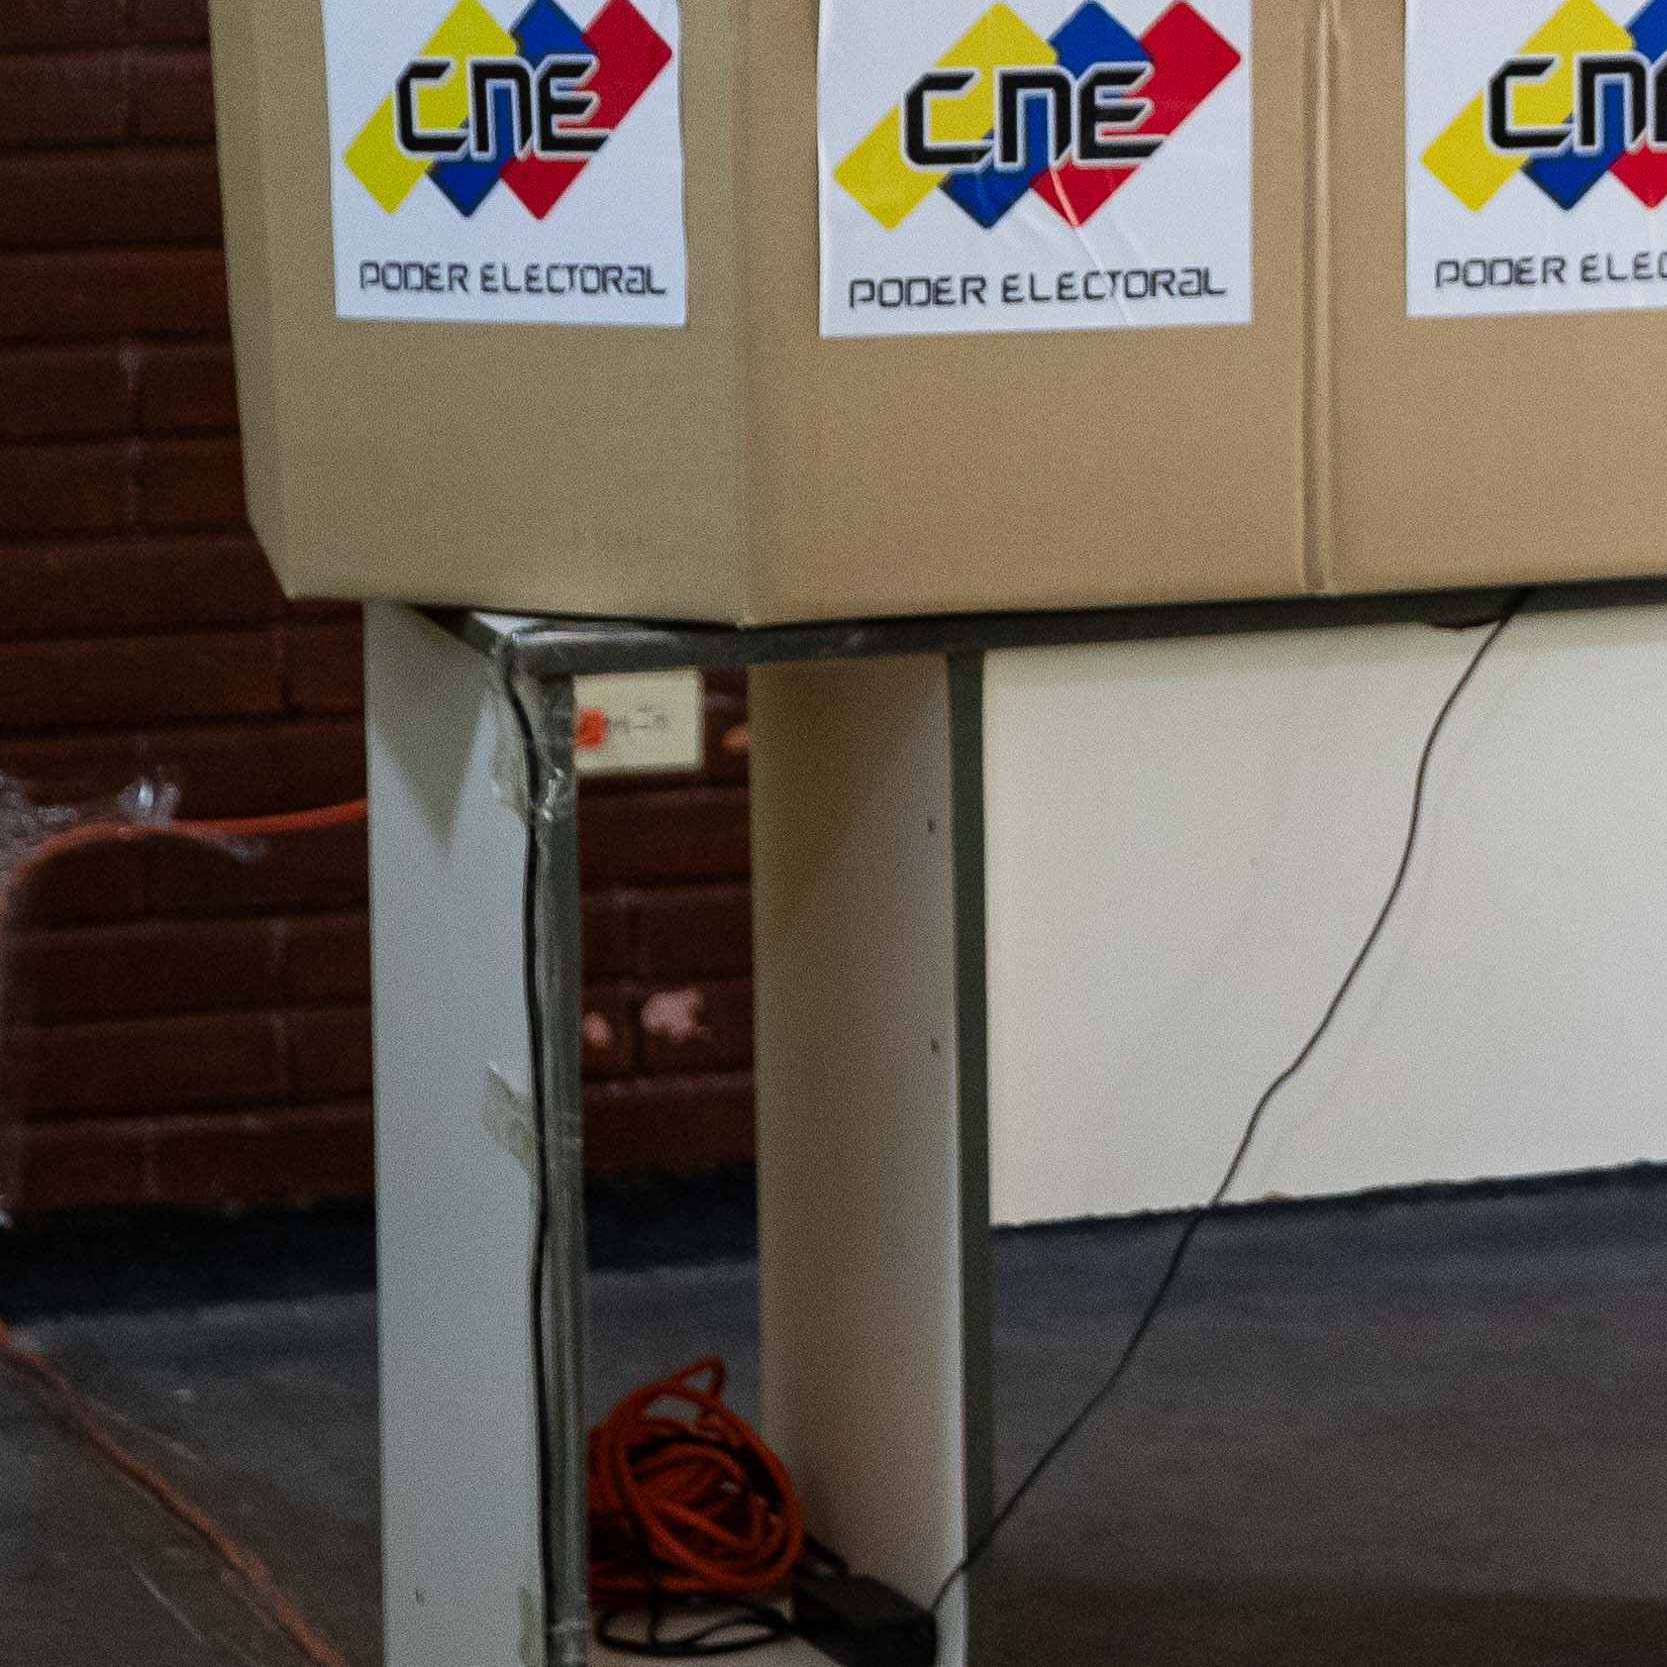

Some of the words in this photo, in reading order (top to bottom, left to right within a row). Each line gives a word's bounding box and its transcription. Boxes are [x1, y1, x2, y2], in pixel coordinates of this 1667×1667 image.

[394, 54, 609, 156] CNE
[902, 61, 1164, 168] CNE
[359, 260, 469, 292] PODER
[1434, 254, 1565, 288] PODER
[849, 275, 987, 310] PODER
